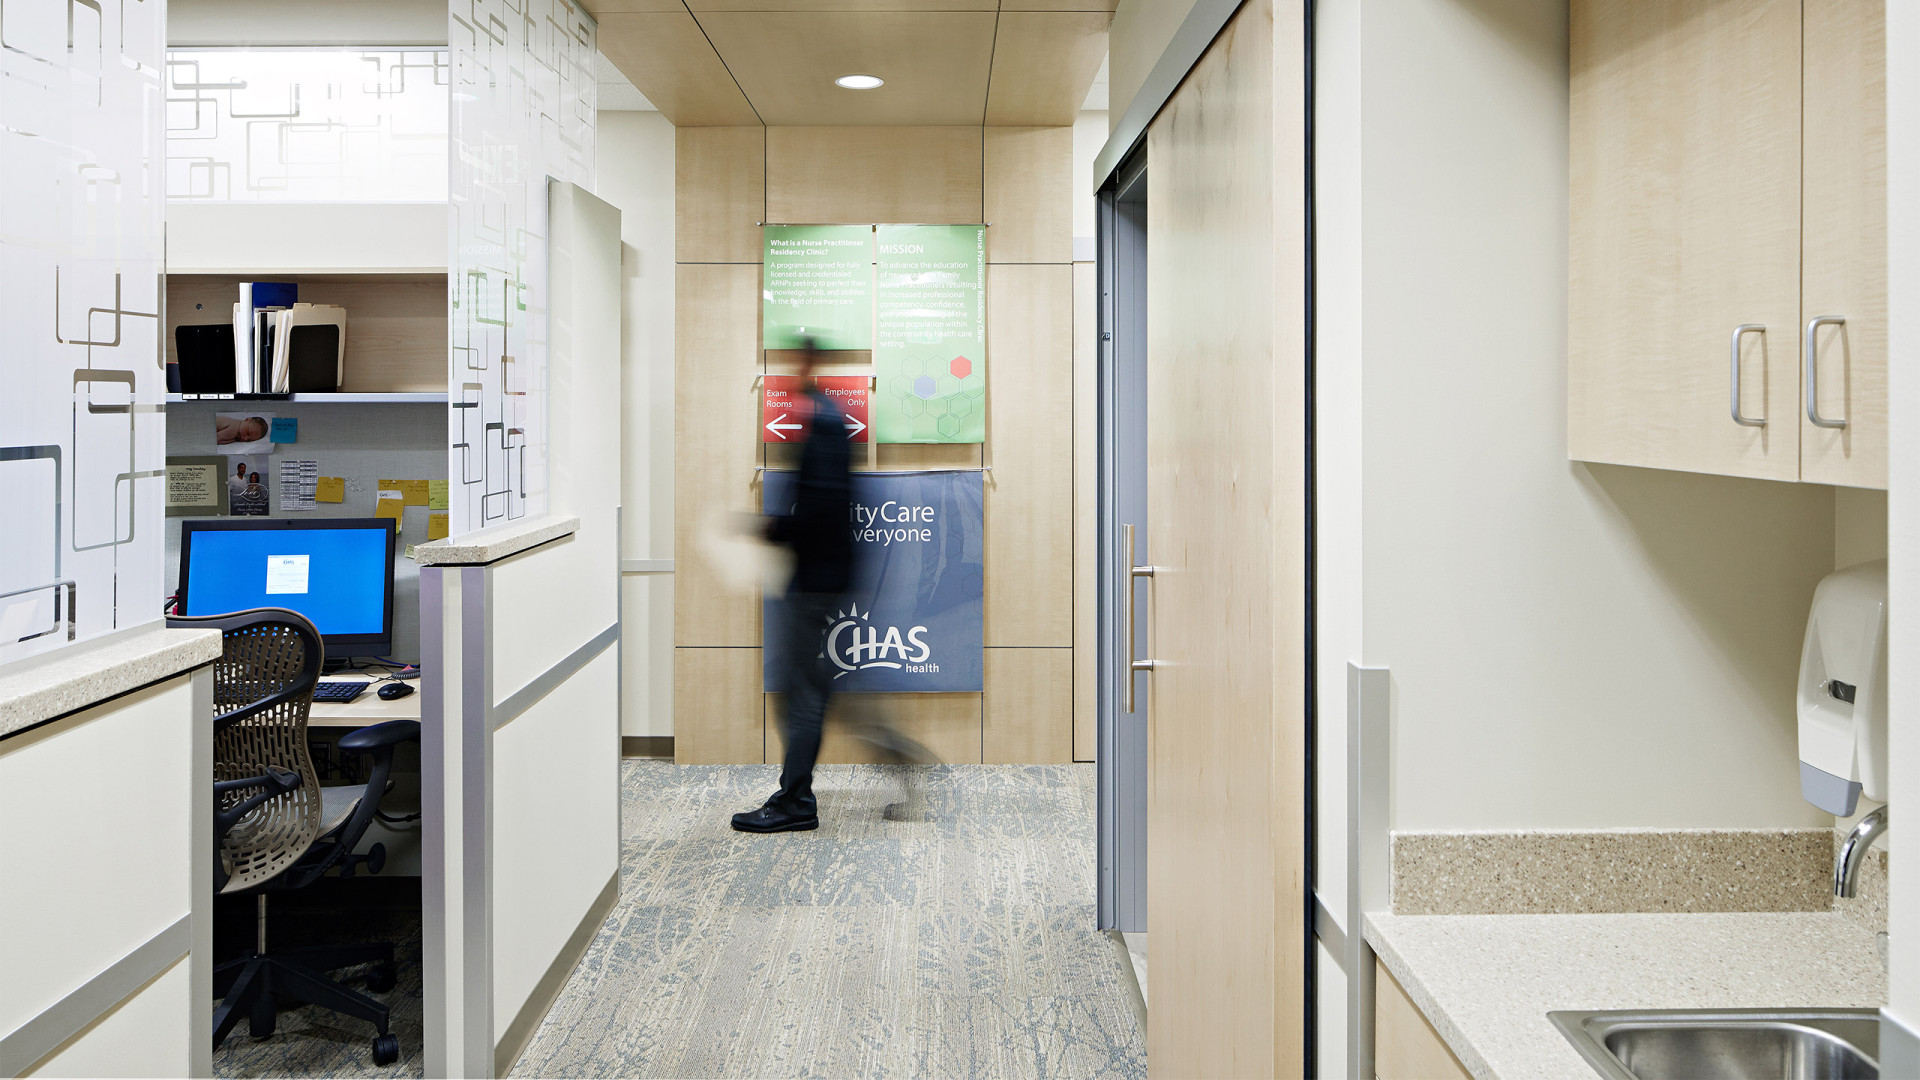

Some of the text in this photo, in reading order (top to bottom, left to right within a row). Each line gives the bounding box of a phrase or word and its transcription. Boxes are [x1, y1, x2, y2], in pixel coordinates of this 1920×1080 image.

[880, 244, 924, 254] MISSION
[880, 272, 887, 280] of
[946, 281, 977, 290] resulting
[824, 388, 866, 397] Employees
[847, 398, 866, 407] Only
[880, 501, 935, 523] Care
[852, 528, 932, 547] veryone
[826, 620, 930, 671] CHAS
[906, 662, 940, 673] health
